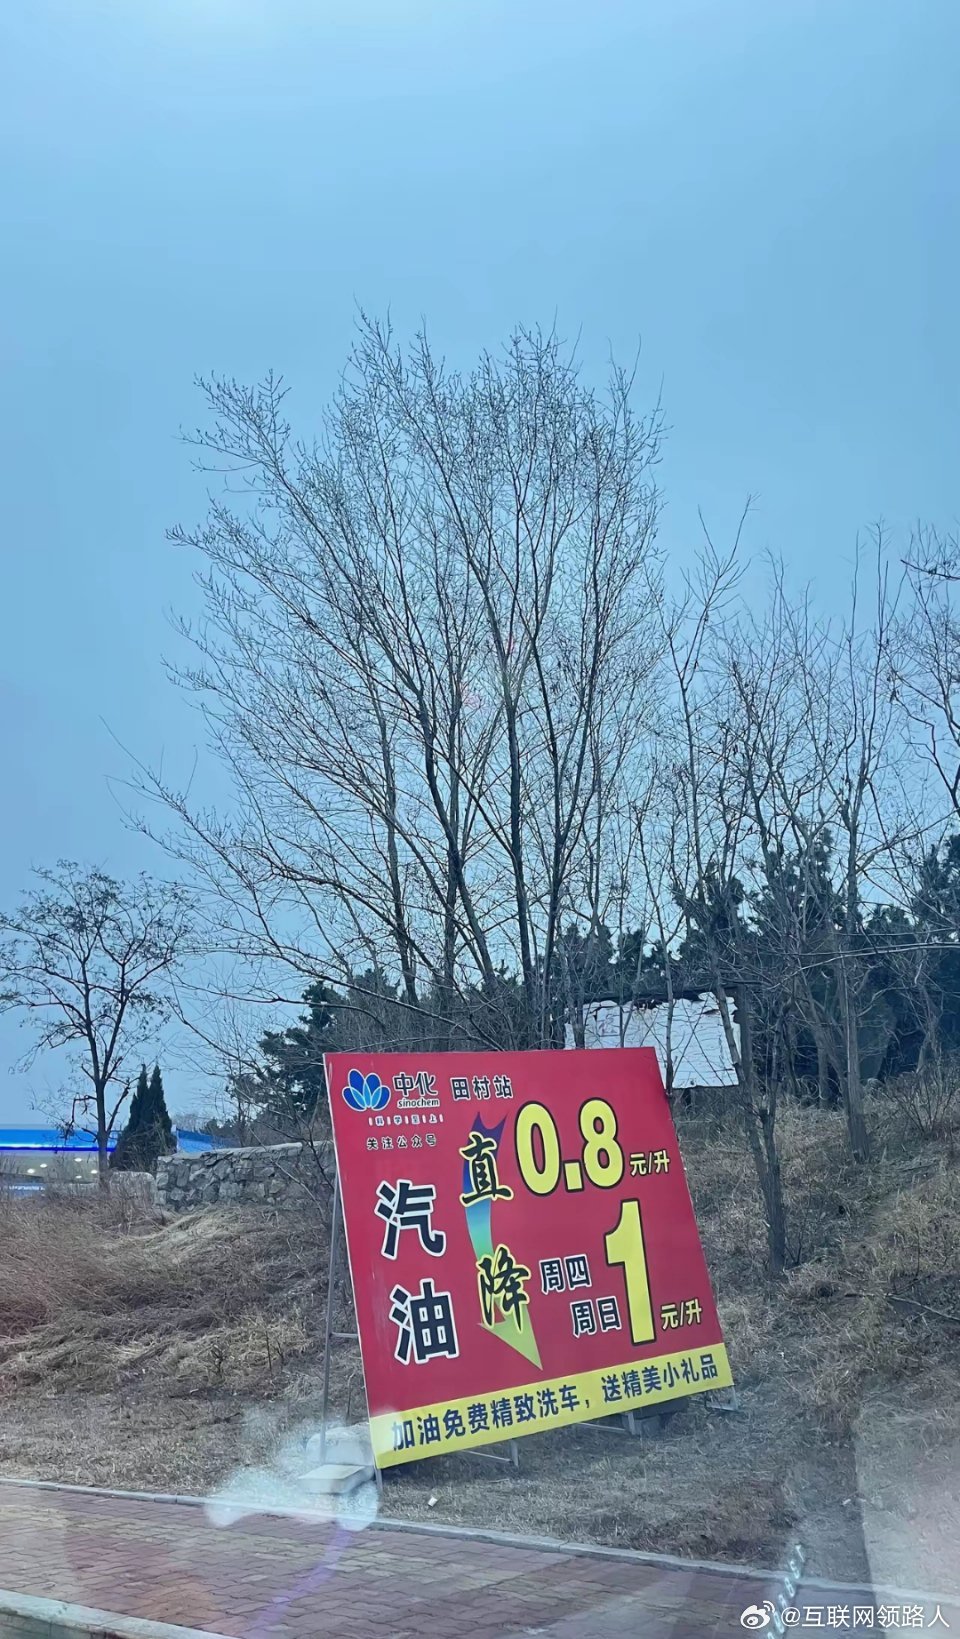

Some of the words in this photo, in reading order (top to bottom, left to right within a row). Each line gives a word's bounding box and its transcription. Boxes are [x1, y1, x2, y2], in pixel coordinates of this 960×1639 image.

[393, 1072, 438, 1096] 中化
[397, 1096, 440, 1109] sinochem
[450, 1075, 514, 1101] 田村站
[366, 1133, 437, 1151] 关注公众号
[514, 1098, 625, 1196] 0.8
[629, 1149, 671, 1178] 元/升
[374, 1179, 460, 1365] 汽油
[539, 1254, 593, 1295] 周四
[604, 1198, 657, 1346] 1
[660, 1298, 703, 1330] 元/升
[570, 1297, 622, 1337] 周日
